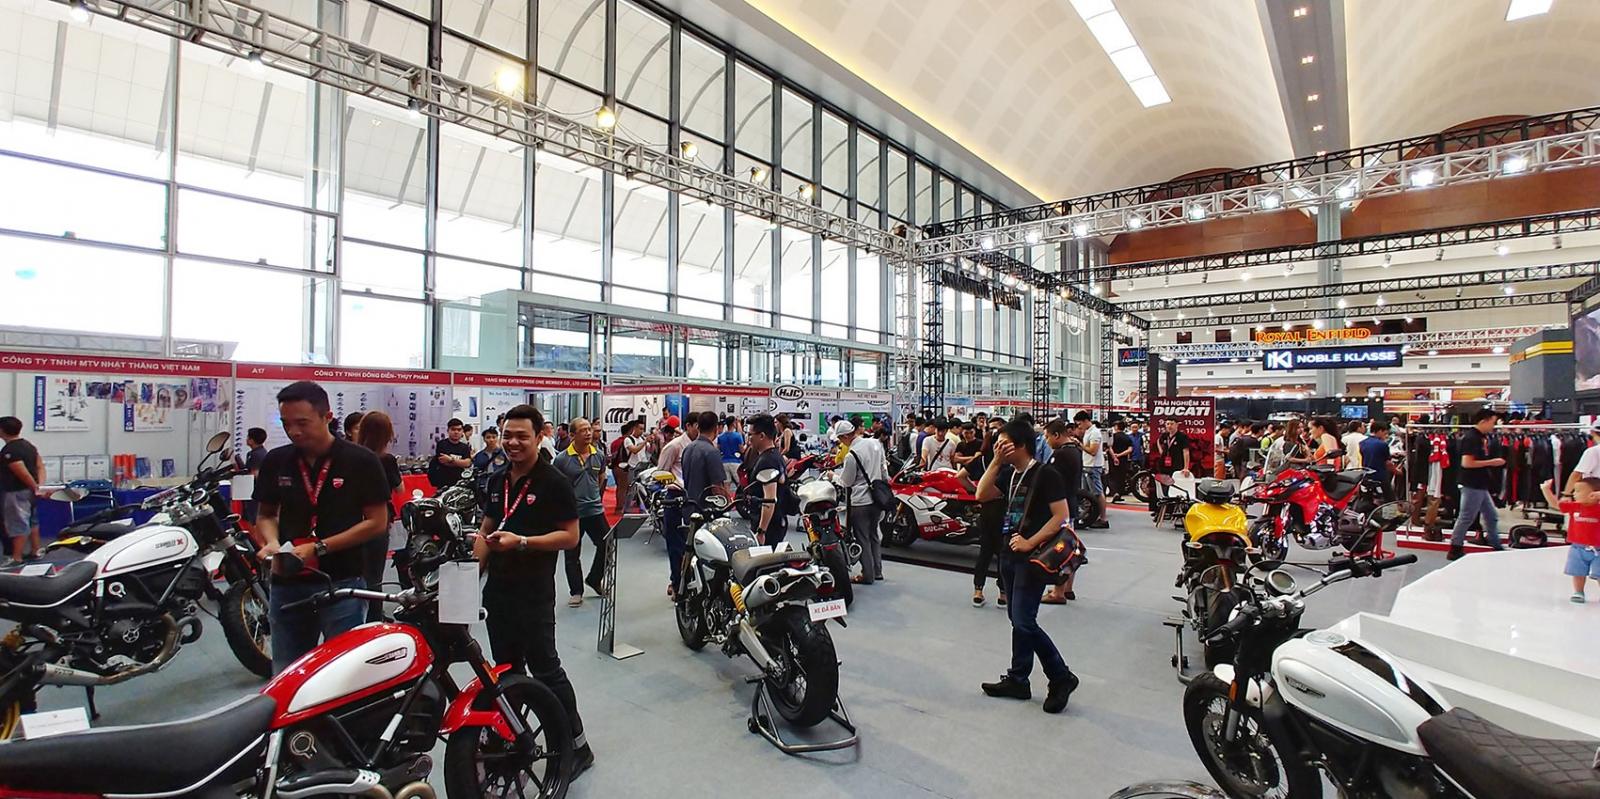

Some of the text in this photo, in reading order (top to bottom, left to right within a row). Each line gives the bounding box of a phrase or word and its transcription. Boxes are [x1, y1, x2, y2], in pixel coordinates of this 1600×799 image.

[1255, 328, 1371, 343] ROYAL ENFIELD
[1, 355, 33, 365] CÔNG
[35, 358, 48, 366] TY
[50, 358, 77, 367] TNHH
[1297, 353, 1341, 363] NOBLE
[1344, 351, 1397, 362] KLASSE
[314, 369, 334, 377] CÔNG
[779, 388, 801, 397] HJC
[1170, 399, 1199, 407] NGHIỆM
[1153, 406, 1211, 416] DUCATI
